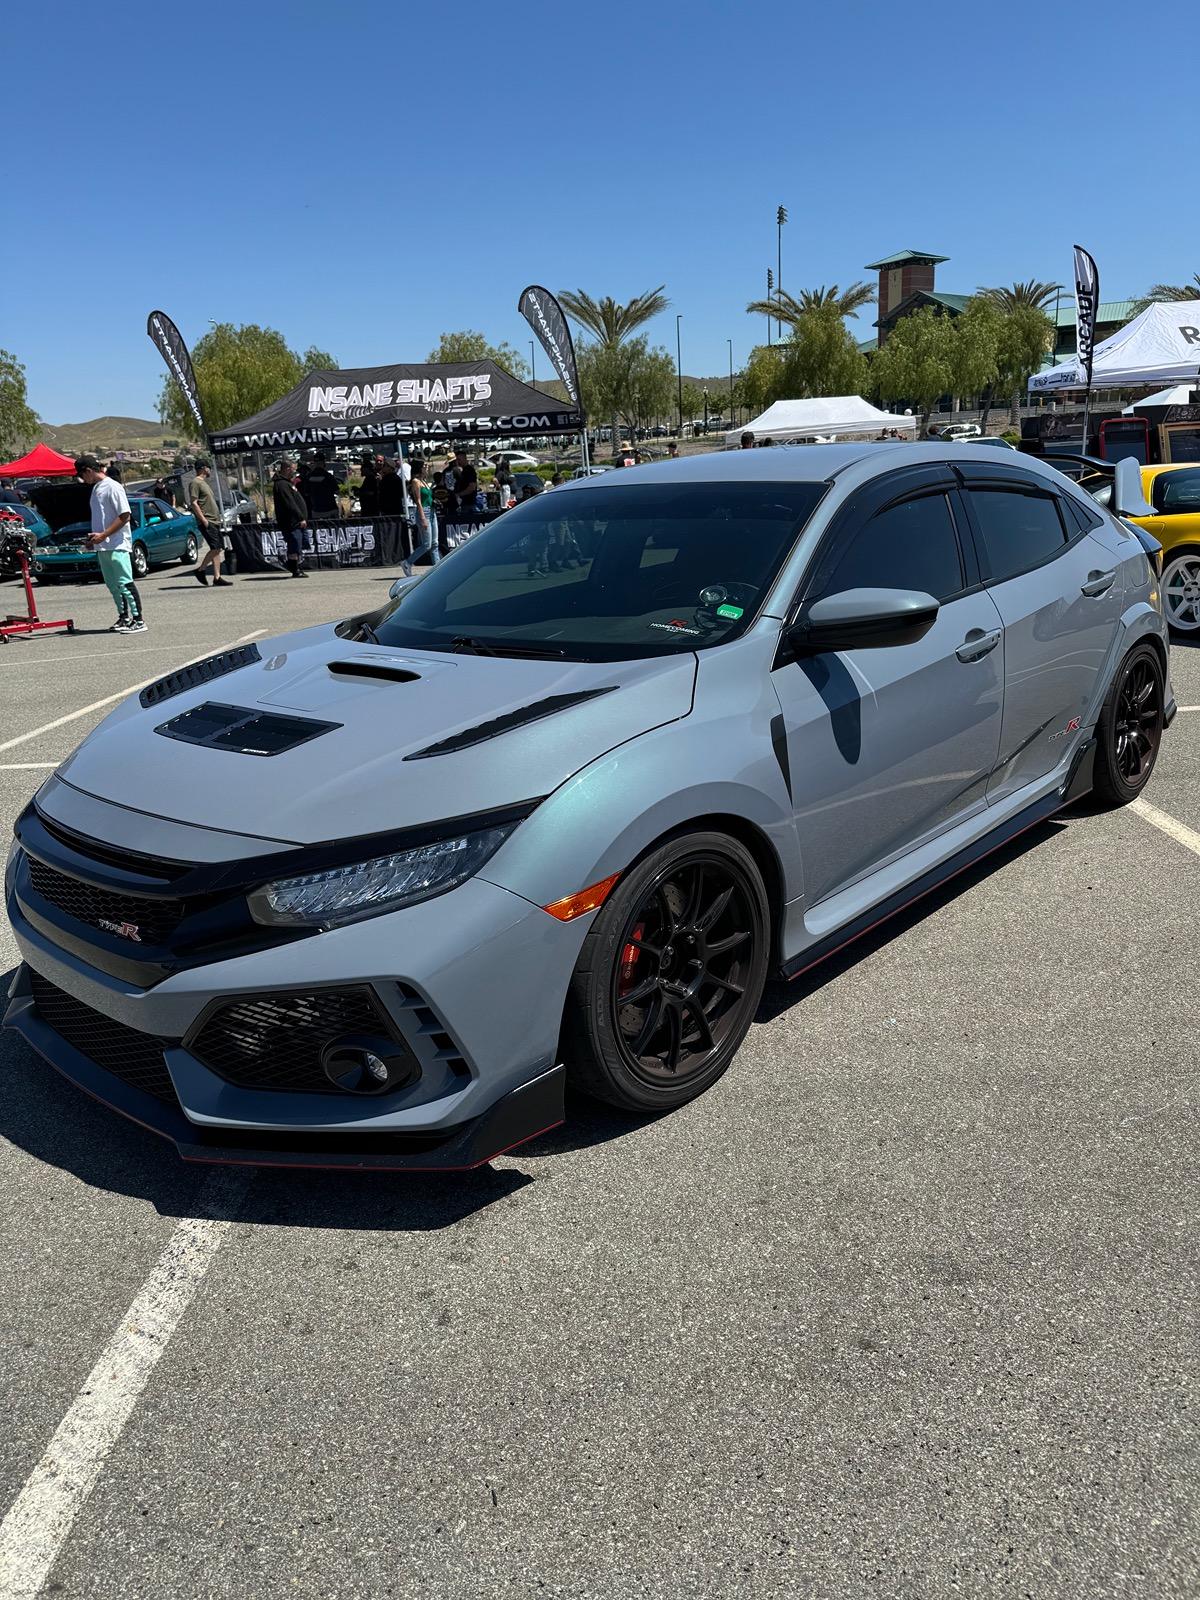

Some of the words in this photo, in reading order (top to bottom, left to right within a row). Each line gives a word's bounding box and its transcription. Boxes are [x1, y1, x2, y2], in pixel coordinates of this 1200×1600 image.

[308, 381, 394, 412] INSANE
[396, 374, 492, 403] SHAFTS
[244, 415, 551, 448] WWW.INSANESHAFTS.COM
[261, 529, 315, 556] INSE
[316, 525, 376, 553] SHAFTS
[121, 921, 142, 941] R
